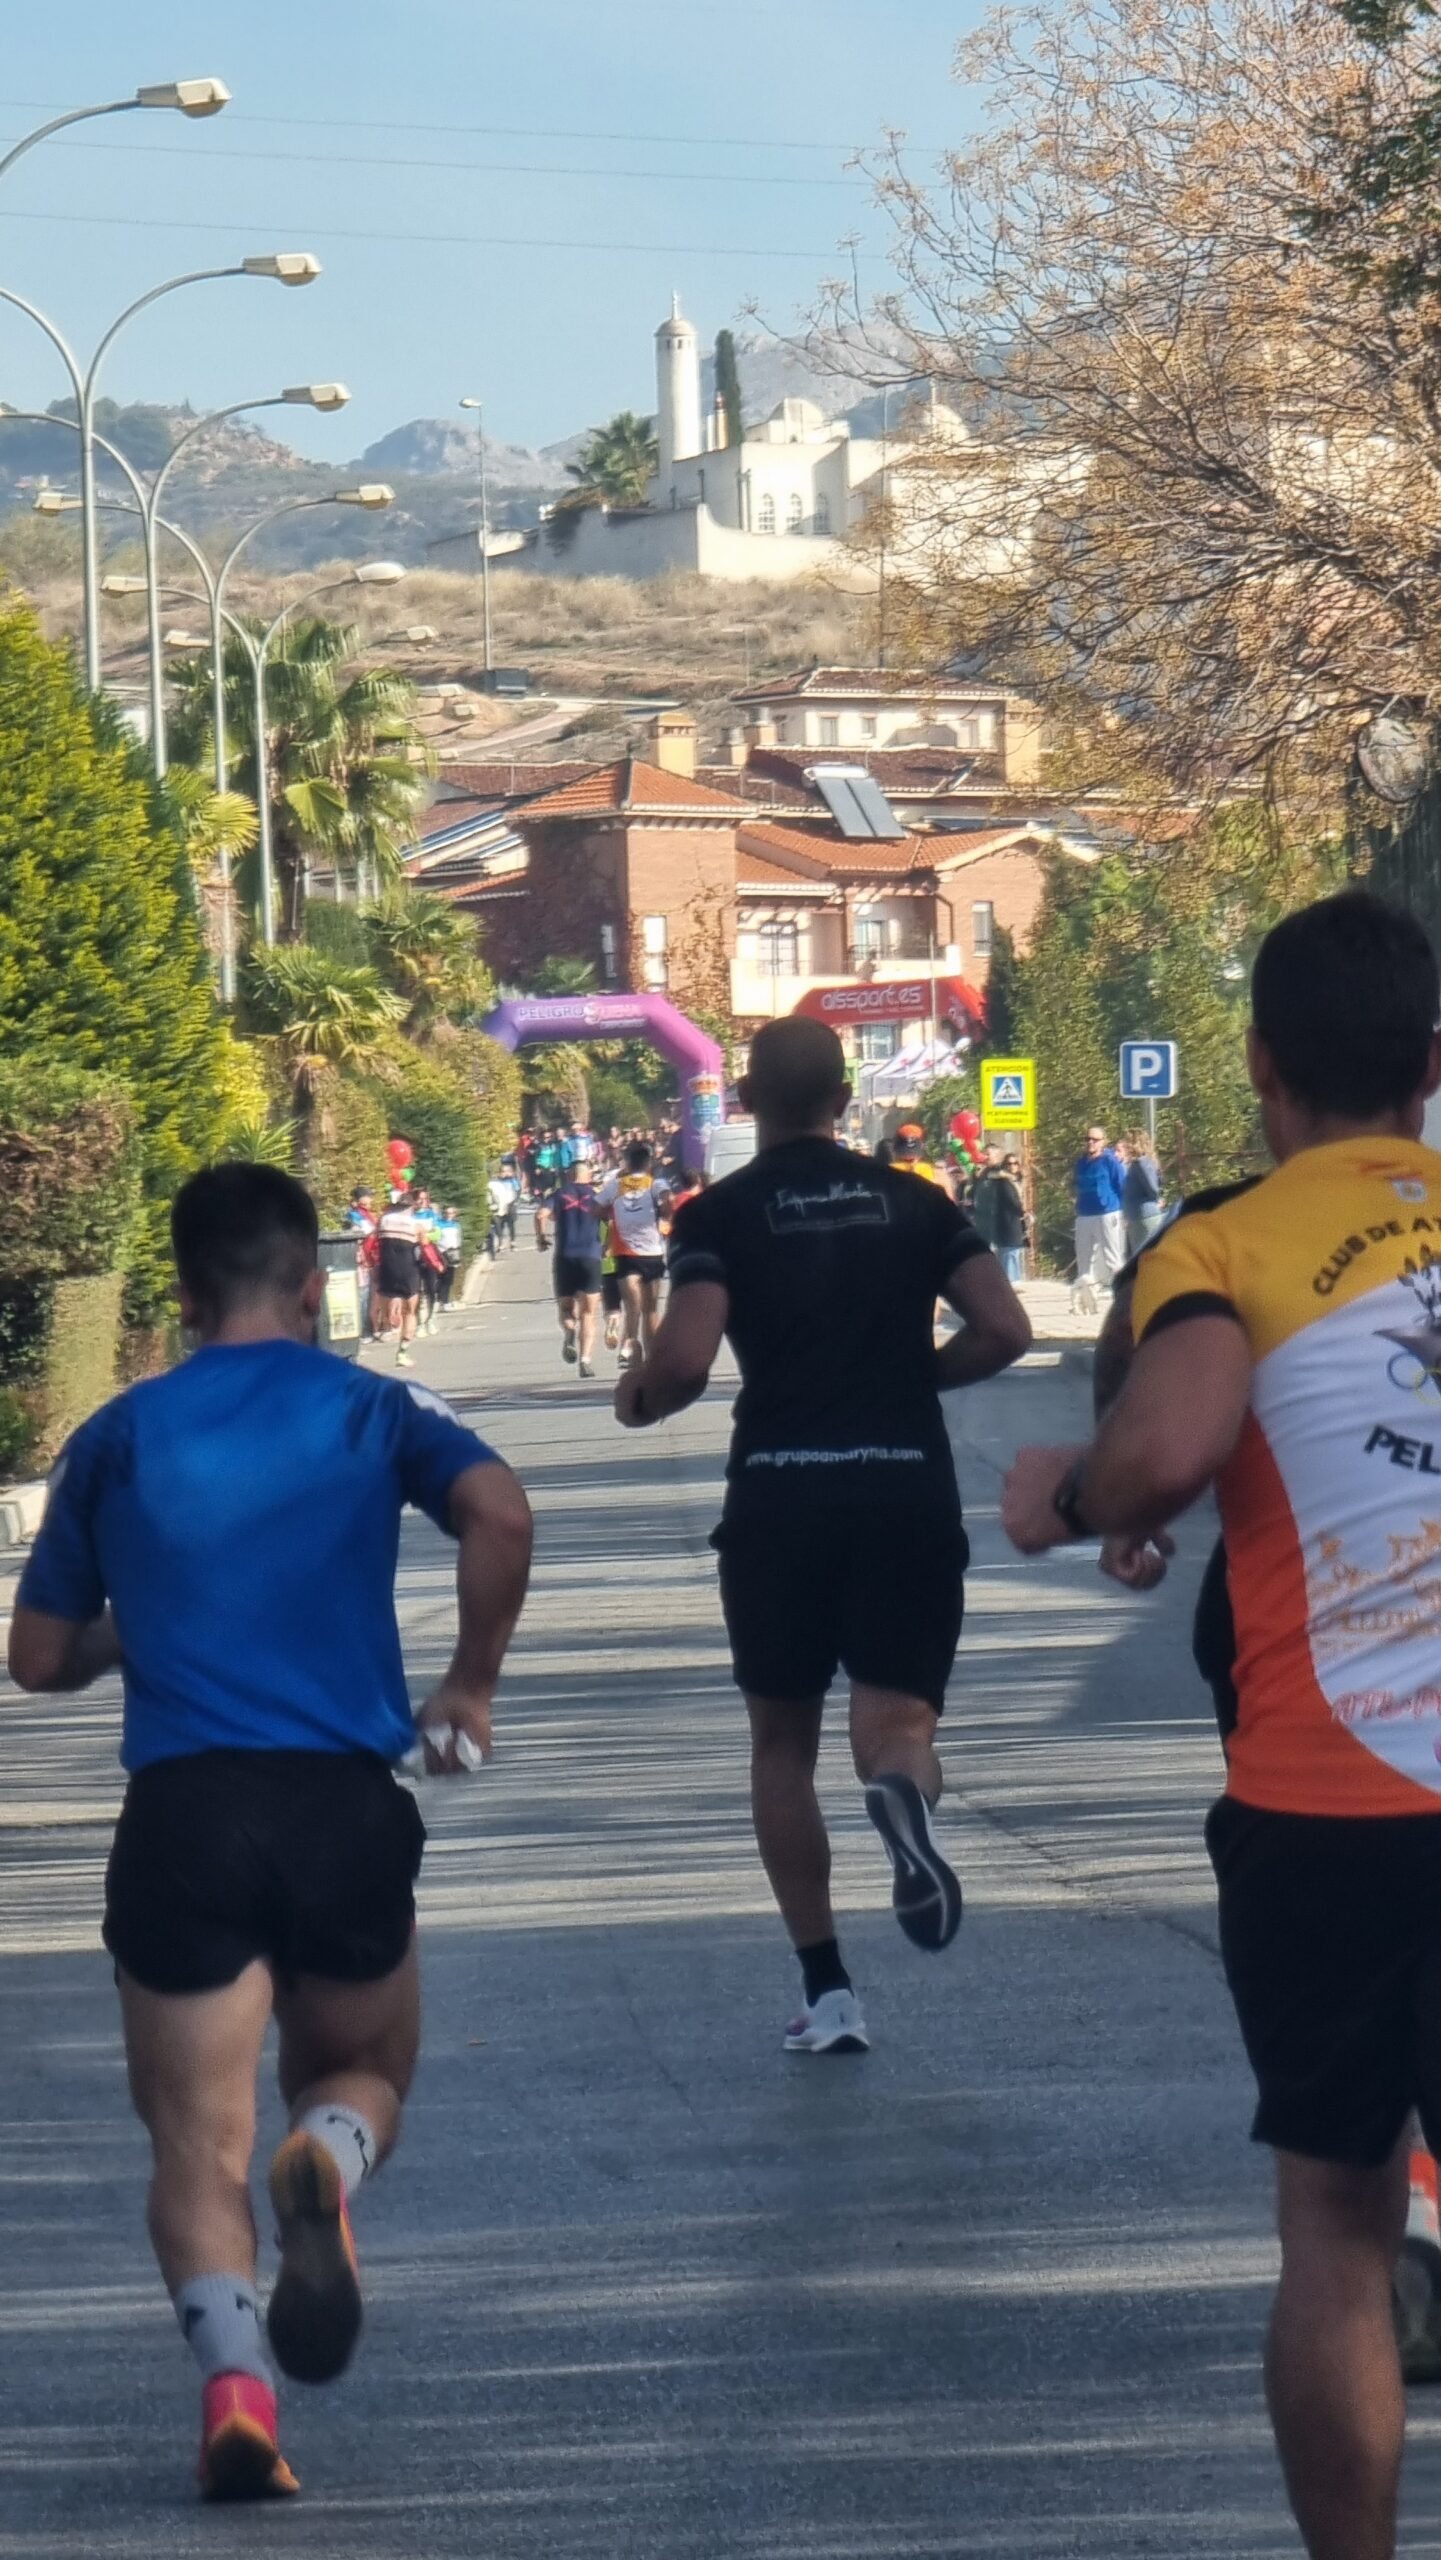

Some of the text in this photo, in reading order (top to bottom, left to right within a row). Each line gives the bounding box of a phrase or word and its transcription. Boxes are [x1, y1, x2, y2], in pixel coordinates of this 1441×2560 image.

[1131, 1049, 1162, 1091] P
[1312, 1235, 1368, 1296] CLUB
[1364, 1219, 1404, 1243] DE
[1363, 1424, 1441, 1475] PEL
